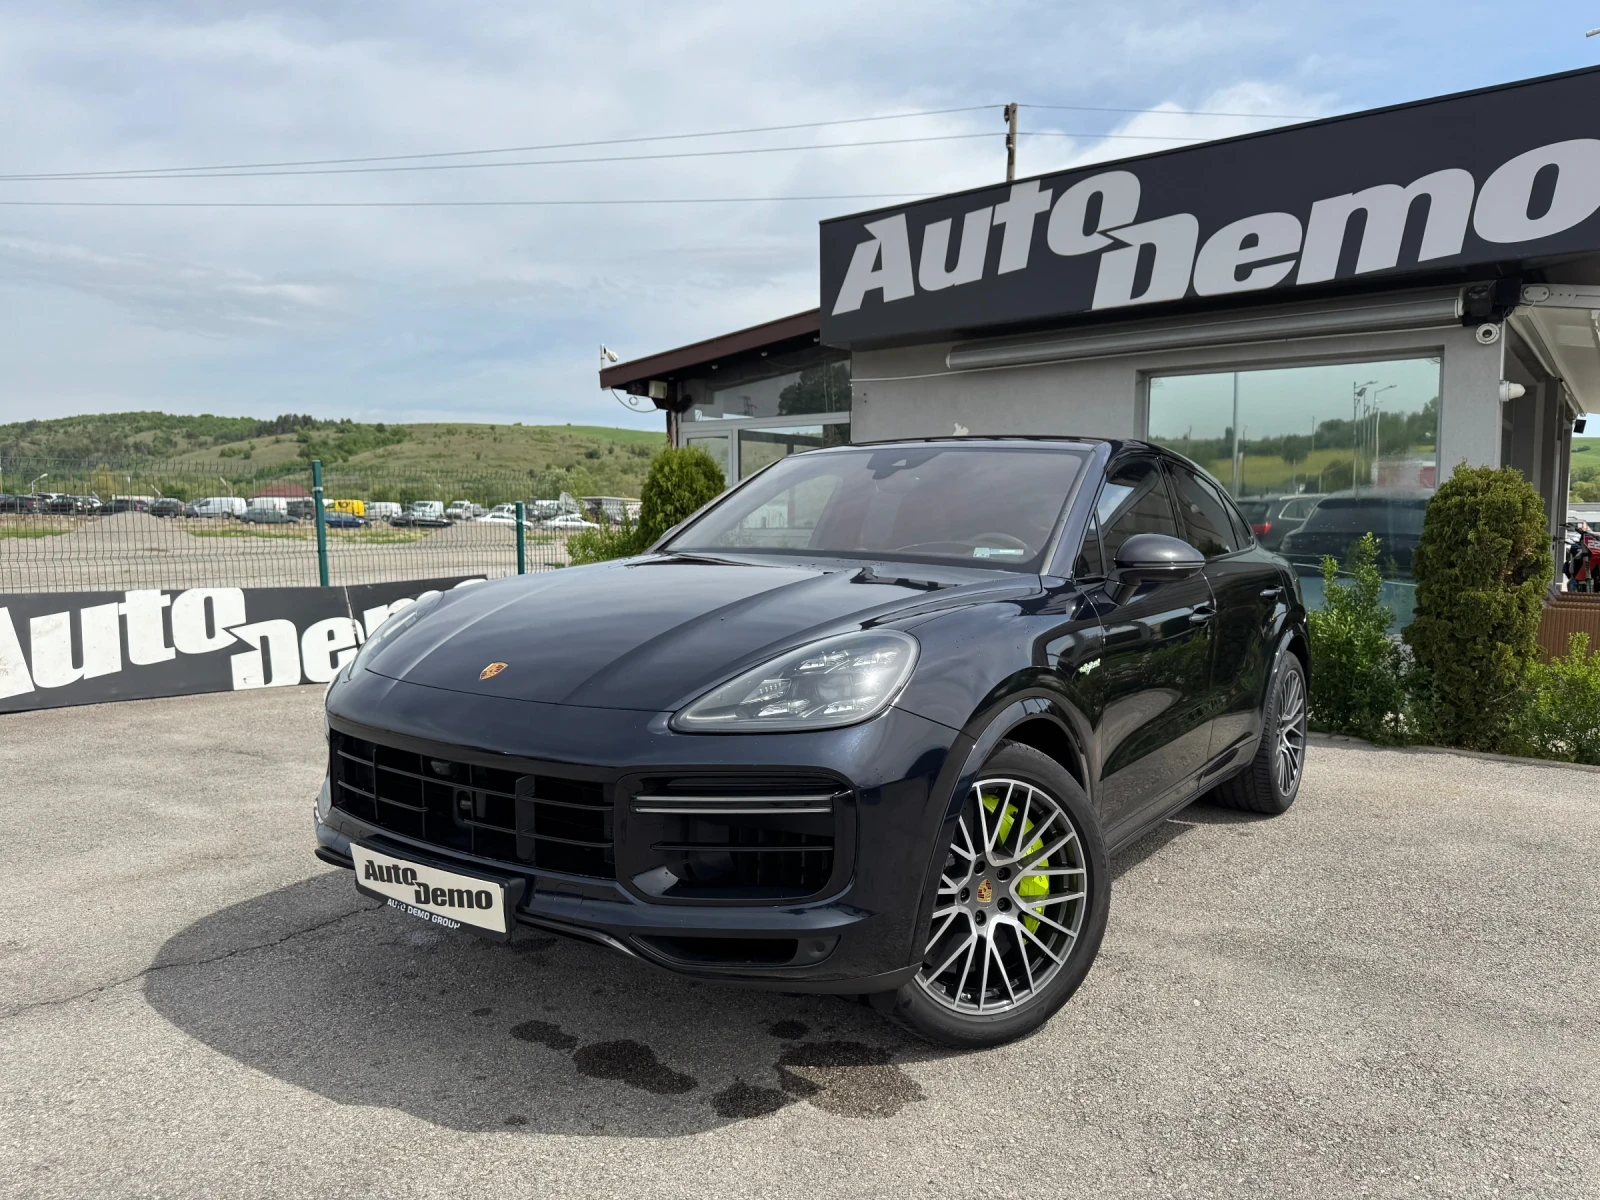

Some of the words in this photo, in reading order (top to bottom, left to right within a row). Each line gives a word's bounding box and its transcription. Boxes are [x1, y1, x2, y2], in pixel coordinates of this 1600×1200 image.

[832, 170, 1141, 315] Auto
[1092, 138, 1600, 310] Demo
[364, 859, 417, 886] Auto
[414, 881, 493, 910] Demo
[407, 905, 430, 920] DEMO
